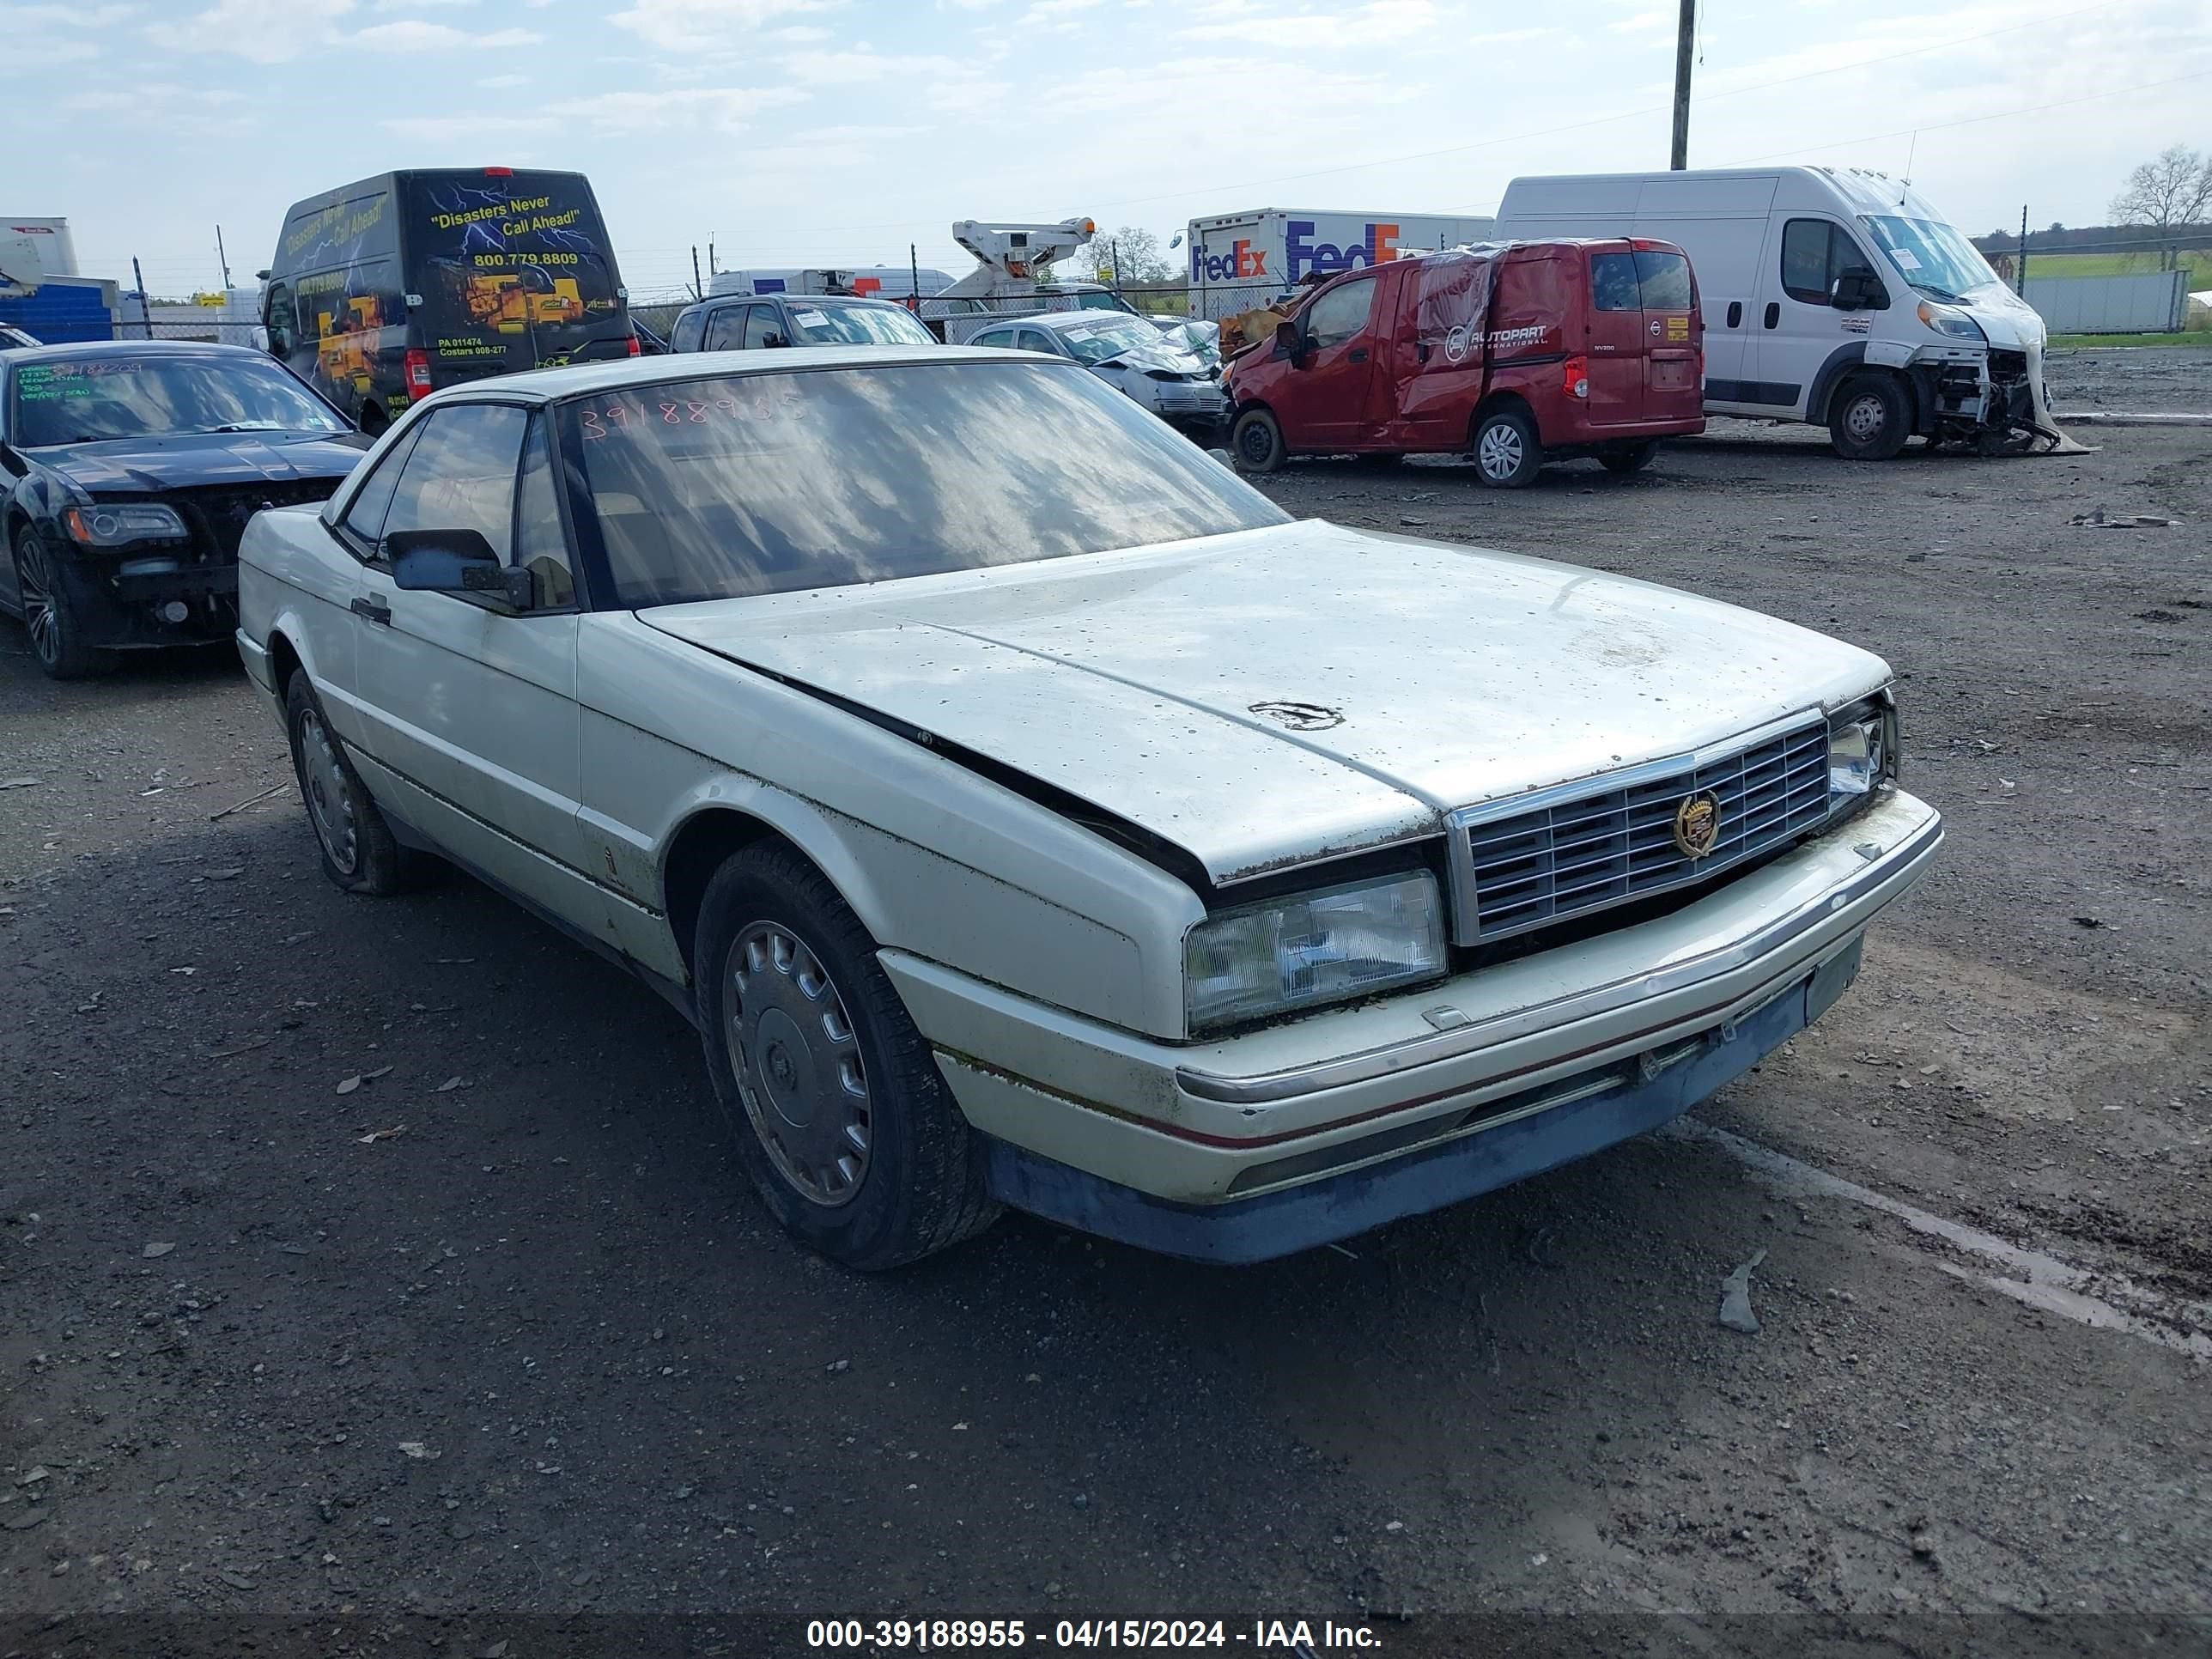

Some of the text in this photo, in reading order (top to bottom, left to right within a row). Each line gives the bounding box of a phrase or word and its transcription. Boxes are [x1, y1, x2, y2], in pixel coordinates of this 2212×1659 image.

[431, 196, 550, 229] "Disasters Never
[502, 209, 580, 236] Call Ahead!"
[334, 219, 350, 247] Call
[474, 252, 578, 267] 800.779.8809
[1192, 240, 1268, 283] FedEx
[1287, 220, 1400, 286] FedE
[1471, 325, 1547, 343] AUTOPART
[440, 346, 507, 356] Costars 008-277
